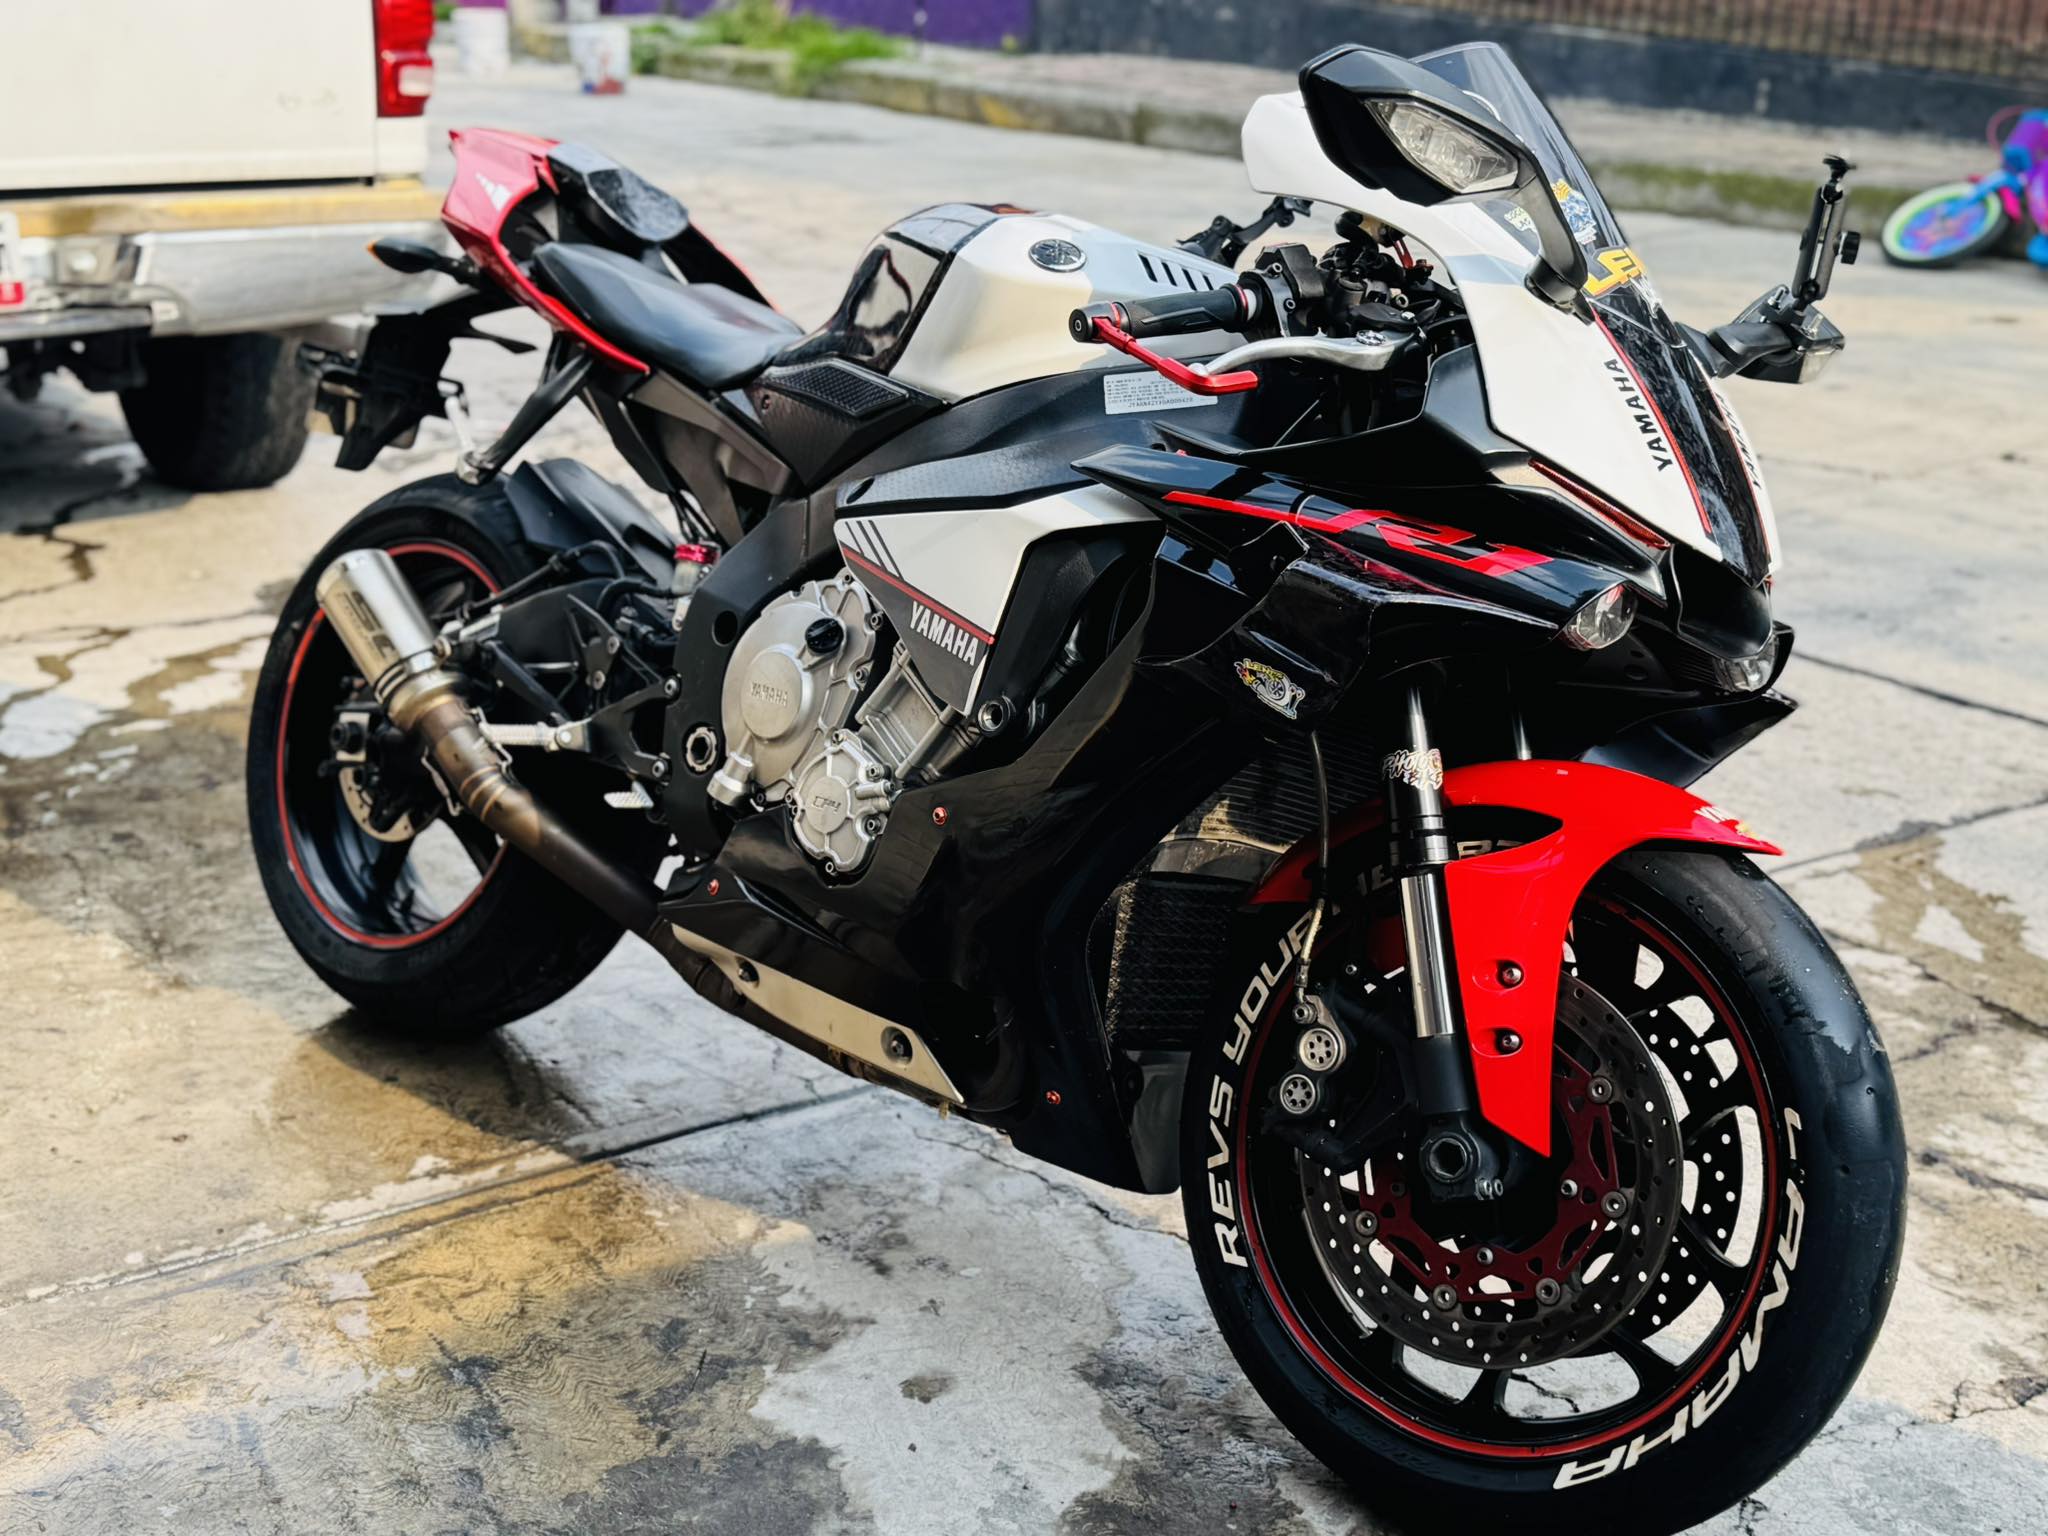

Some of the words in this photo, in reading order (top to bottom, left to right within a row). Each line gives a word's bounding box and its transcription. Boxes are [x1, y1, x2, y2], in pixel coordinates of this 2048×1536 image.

[1604, 358, 1673, 472] YAMAHA
[909, 600, 980, 667] YAMAHA
[751, 682, 788, 707] YAMAHA
[1223, 908, 1315, 1066] YOUR
[1207, 1074, 1249, 1268] REVS
